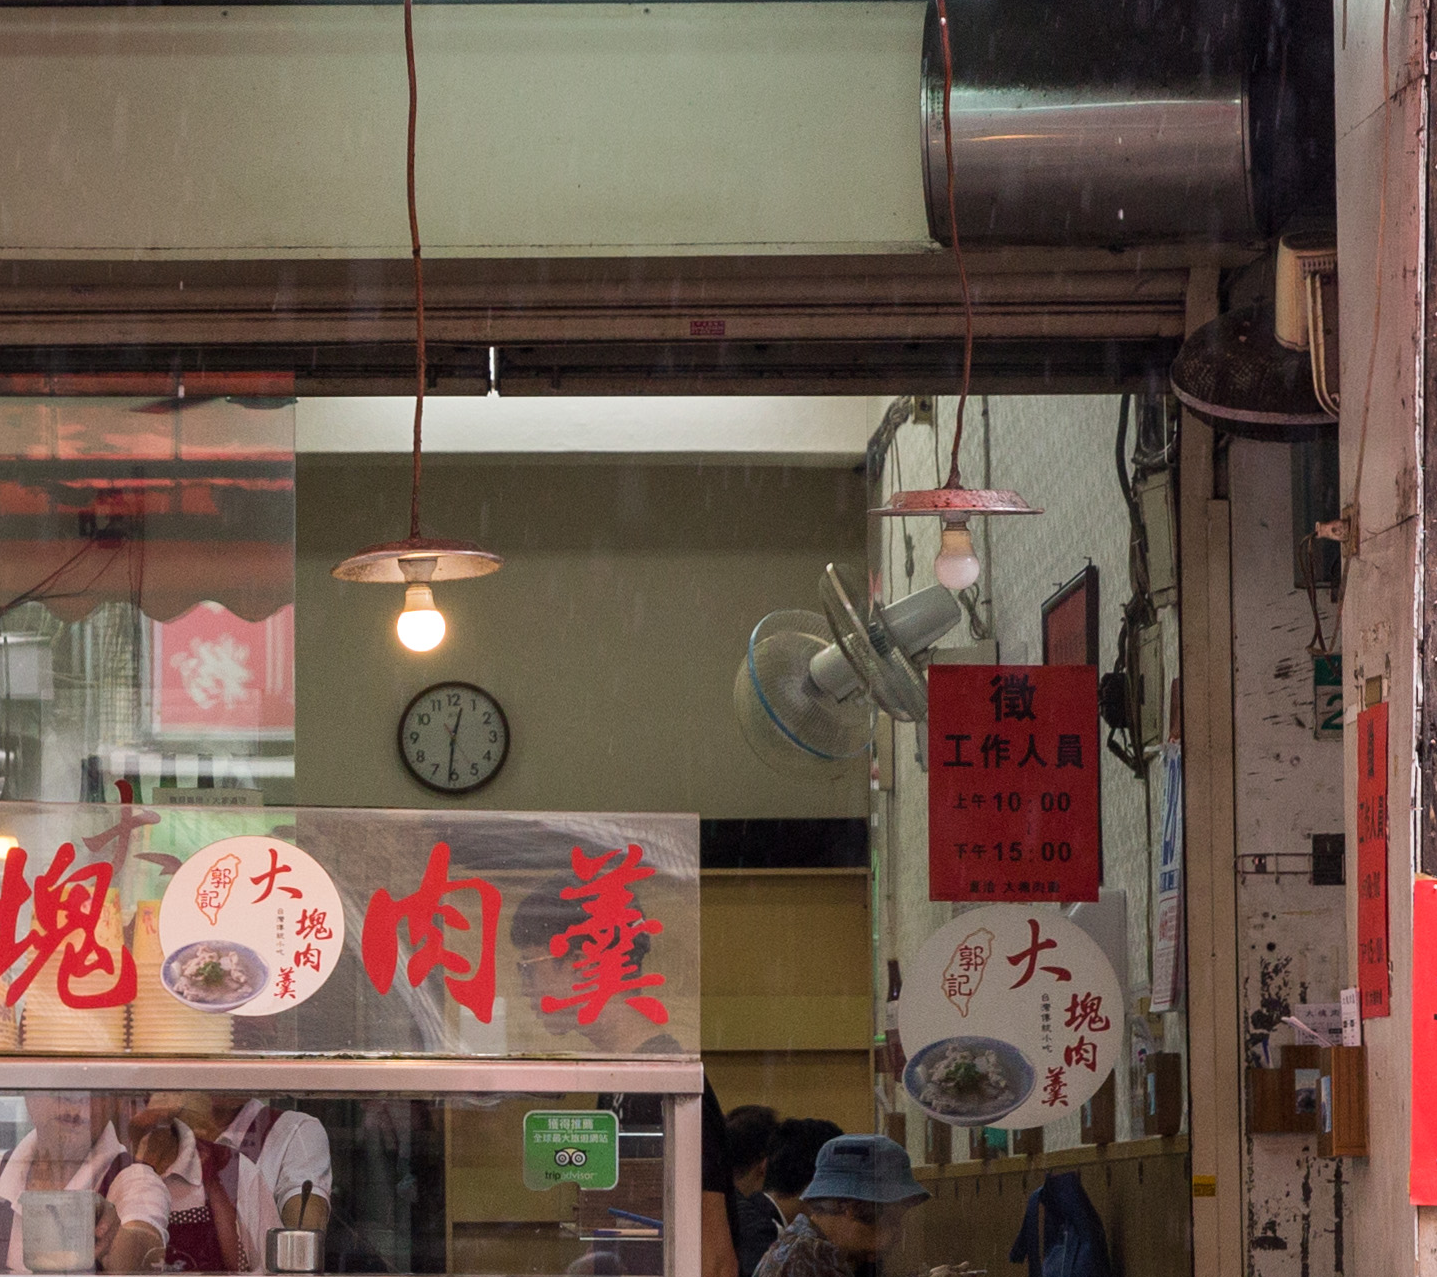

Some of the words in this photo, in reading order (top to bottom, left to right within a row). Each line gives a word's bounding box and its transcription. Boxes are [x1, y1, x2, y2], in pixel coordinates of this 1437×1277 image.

[990, 674, 1037, 721] 徵
[943, 734, 1084, 769] 工作人員
[198, 868, 233, 910] 郭記
[249, 848, 333, 999] 大塊肉羹
[946, 945, 985, 997] 郭記
[1006, 919, 1111, 1107] 大塊肉羹
[544, 1170, 595, 1181] tripadvisor
